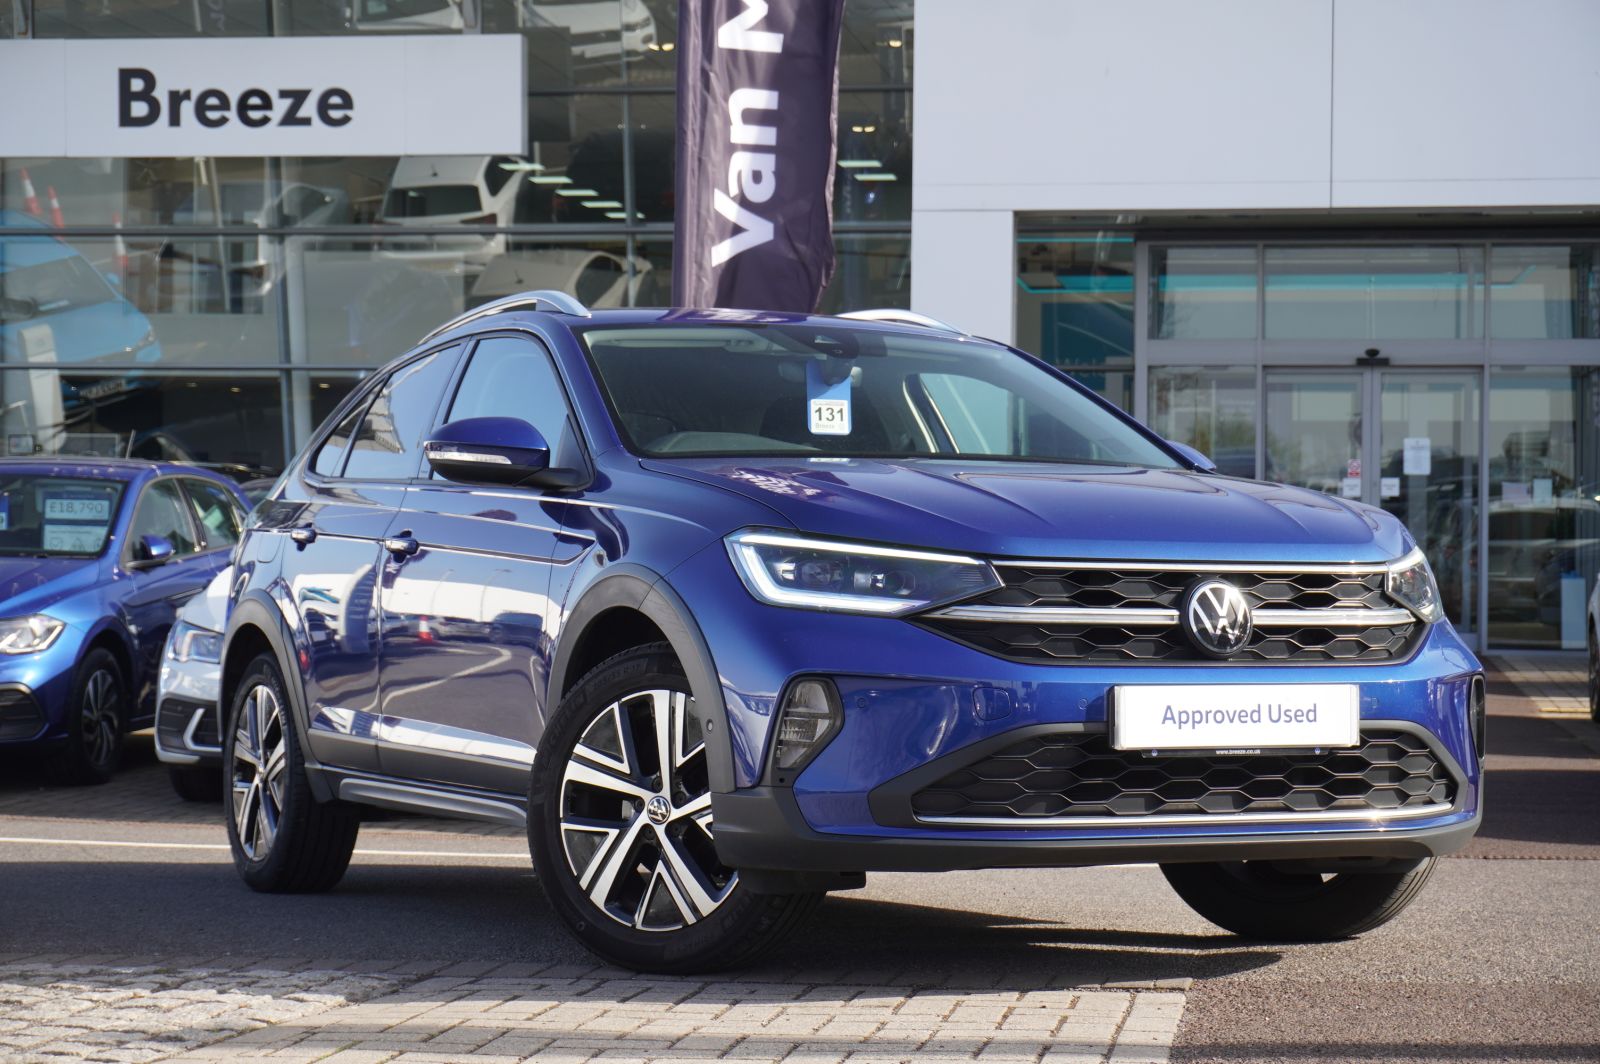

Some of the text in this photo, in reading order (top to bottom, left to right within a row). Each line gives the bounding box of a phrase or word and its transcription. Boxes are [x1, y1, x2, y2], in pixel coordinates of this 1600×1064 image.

[118, 67, 354, 129] Breeze
[711, 87, 780, 268] Van
[814, 406, 844, 422] 131
[49, 501, 104, 514] £18,790
[1161, 703, 1317, 730] Approved Used
